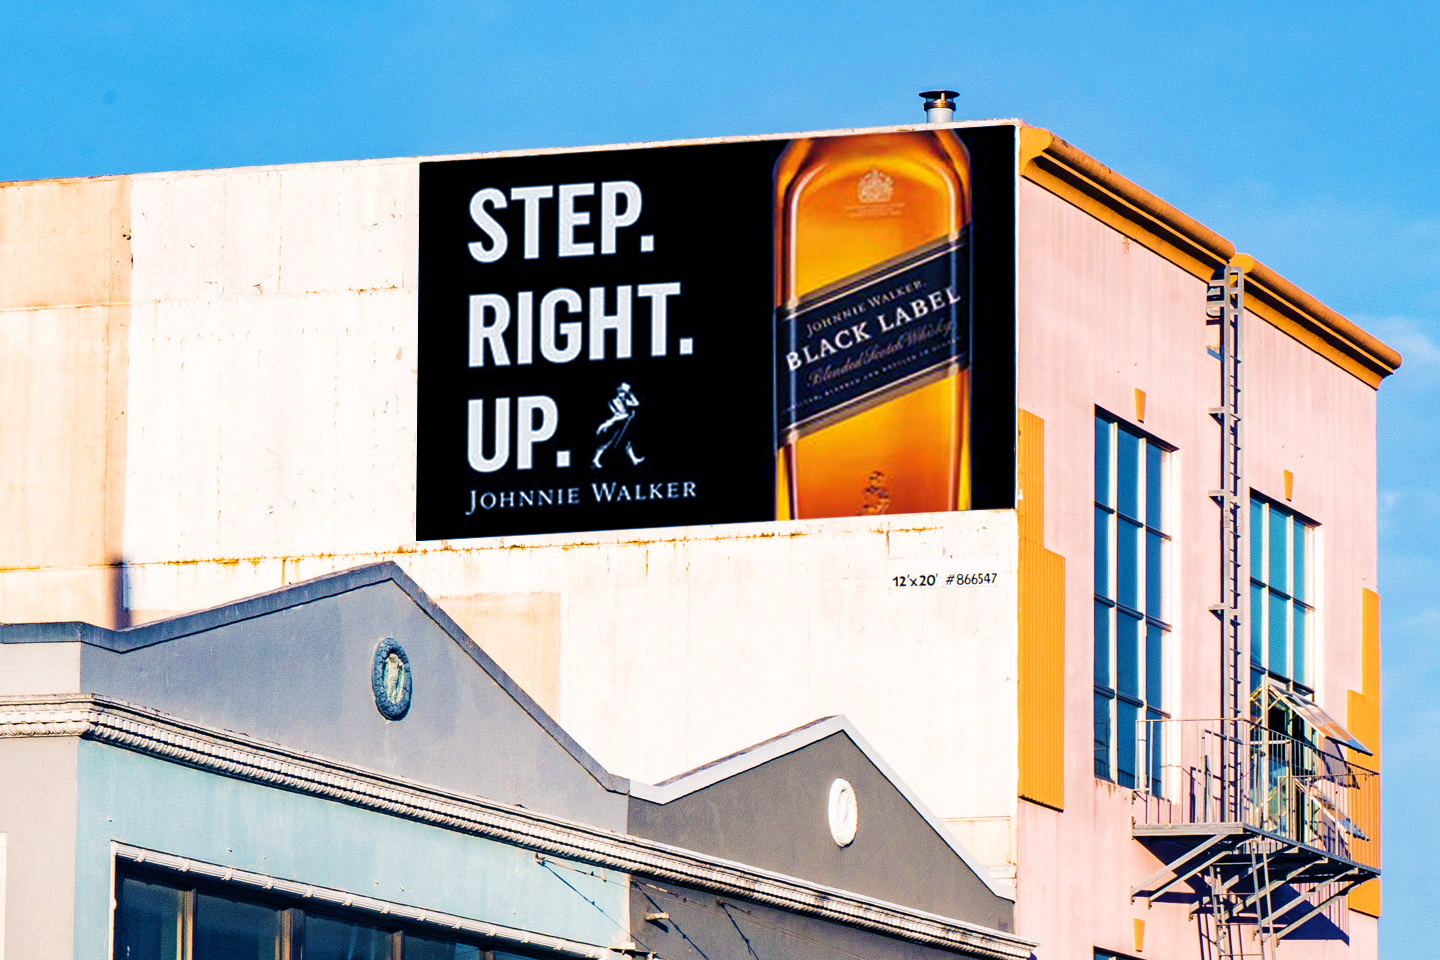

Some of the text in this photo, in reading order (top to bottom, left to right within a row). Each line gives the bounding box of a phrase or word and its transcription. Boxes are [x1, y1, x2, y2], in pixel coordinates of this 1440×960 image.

[468, 180, 654, 263] STEP.
[468, 282, 693, 367] RIGHT.
[785, 321, 872, 372] BLACK
[877, 285, 961, 333] LABEL
[806, 301, 867, 338] JOHNNIE
[467, 395, 570, 473] UP.
[465, 481, 697, 515] JOHNNIE WALKER
[945, 573, 997, 586] #866547
